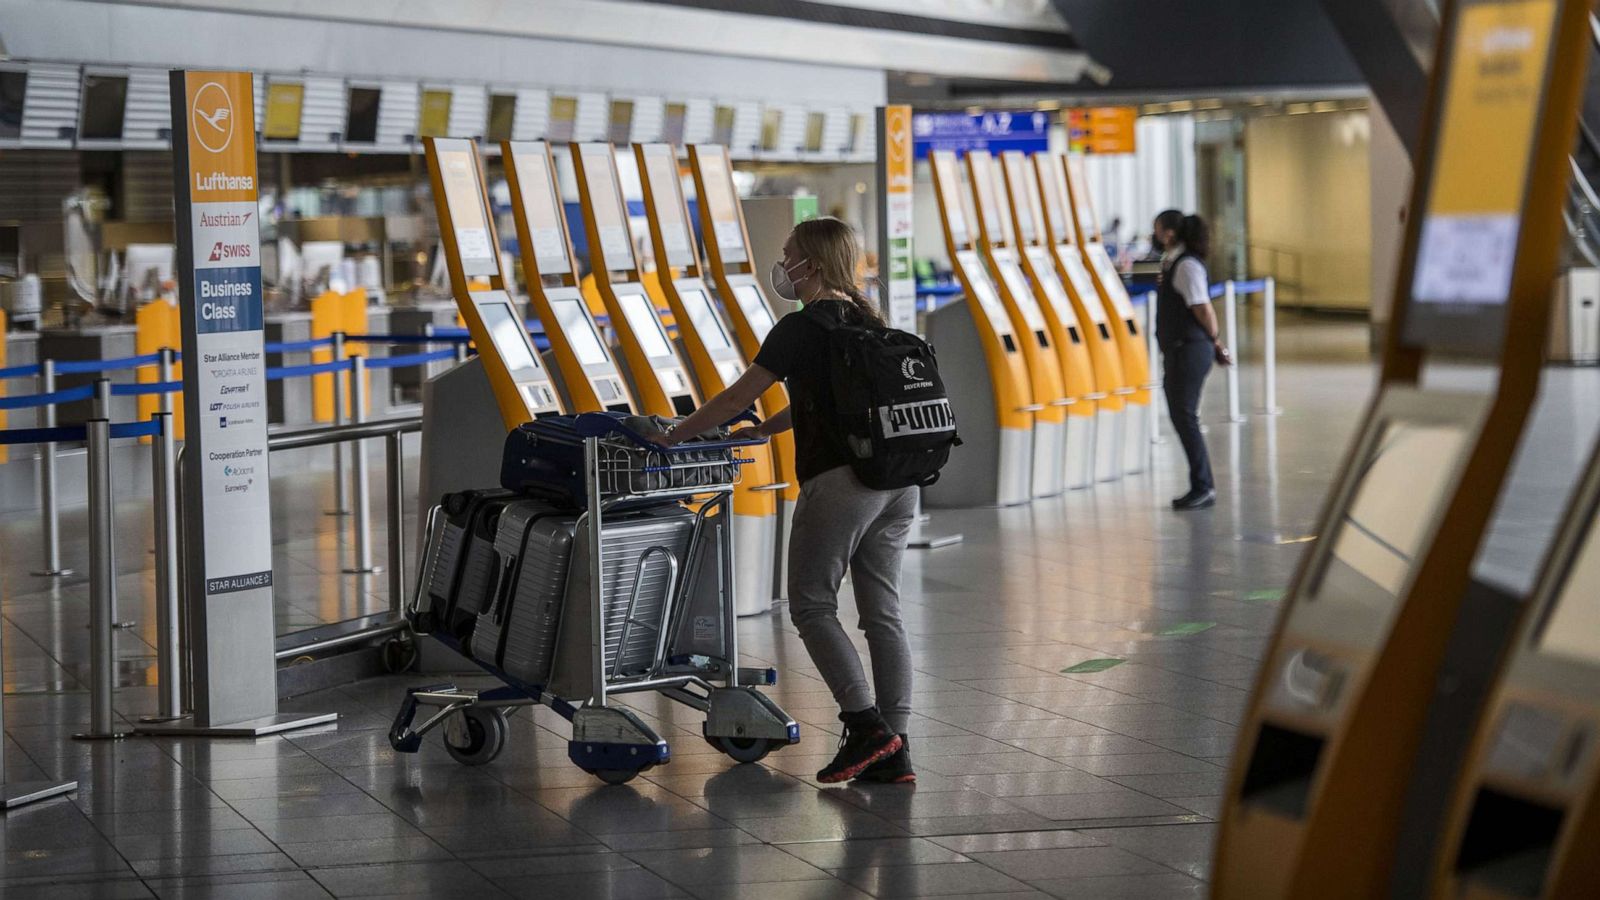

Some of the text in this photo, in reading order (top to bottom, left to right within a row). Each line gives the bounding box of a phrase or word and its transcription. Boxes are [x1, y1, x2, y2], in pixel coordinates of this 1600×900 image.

[196, 172, 254, 191] Lufthansa
[200, 211, 241, 227] Austrian
[223, 244, 251, 258] SWISS
[200, 279, 252, 298] Business
[202, 302, 236, 320] Class
[203, 352, 260, 363] Star Alliance Member
[903, 382, 920, 391] SILVER
[209, 402, 223, 411] LOT
[889, 402, 954, 433] PUMA
[209, 449, 263, 461] Cooperation Partner
[209, 575, 264, 592] STAR ALLIANCE
